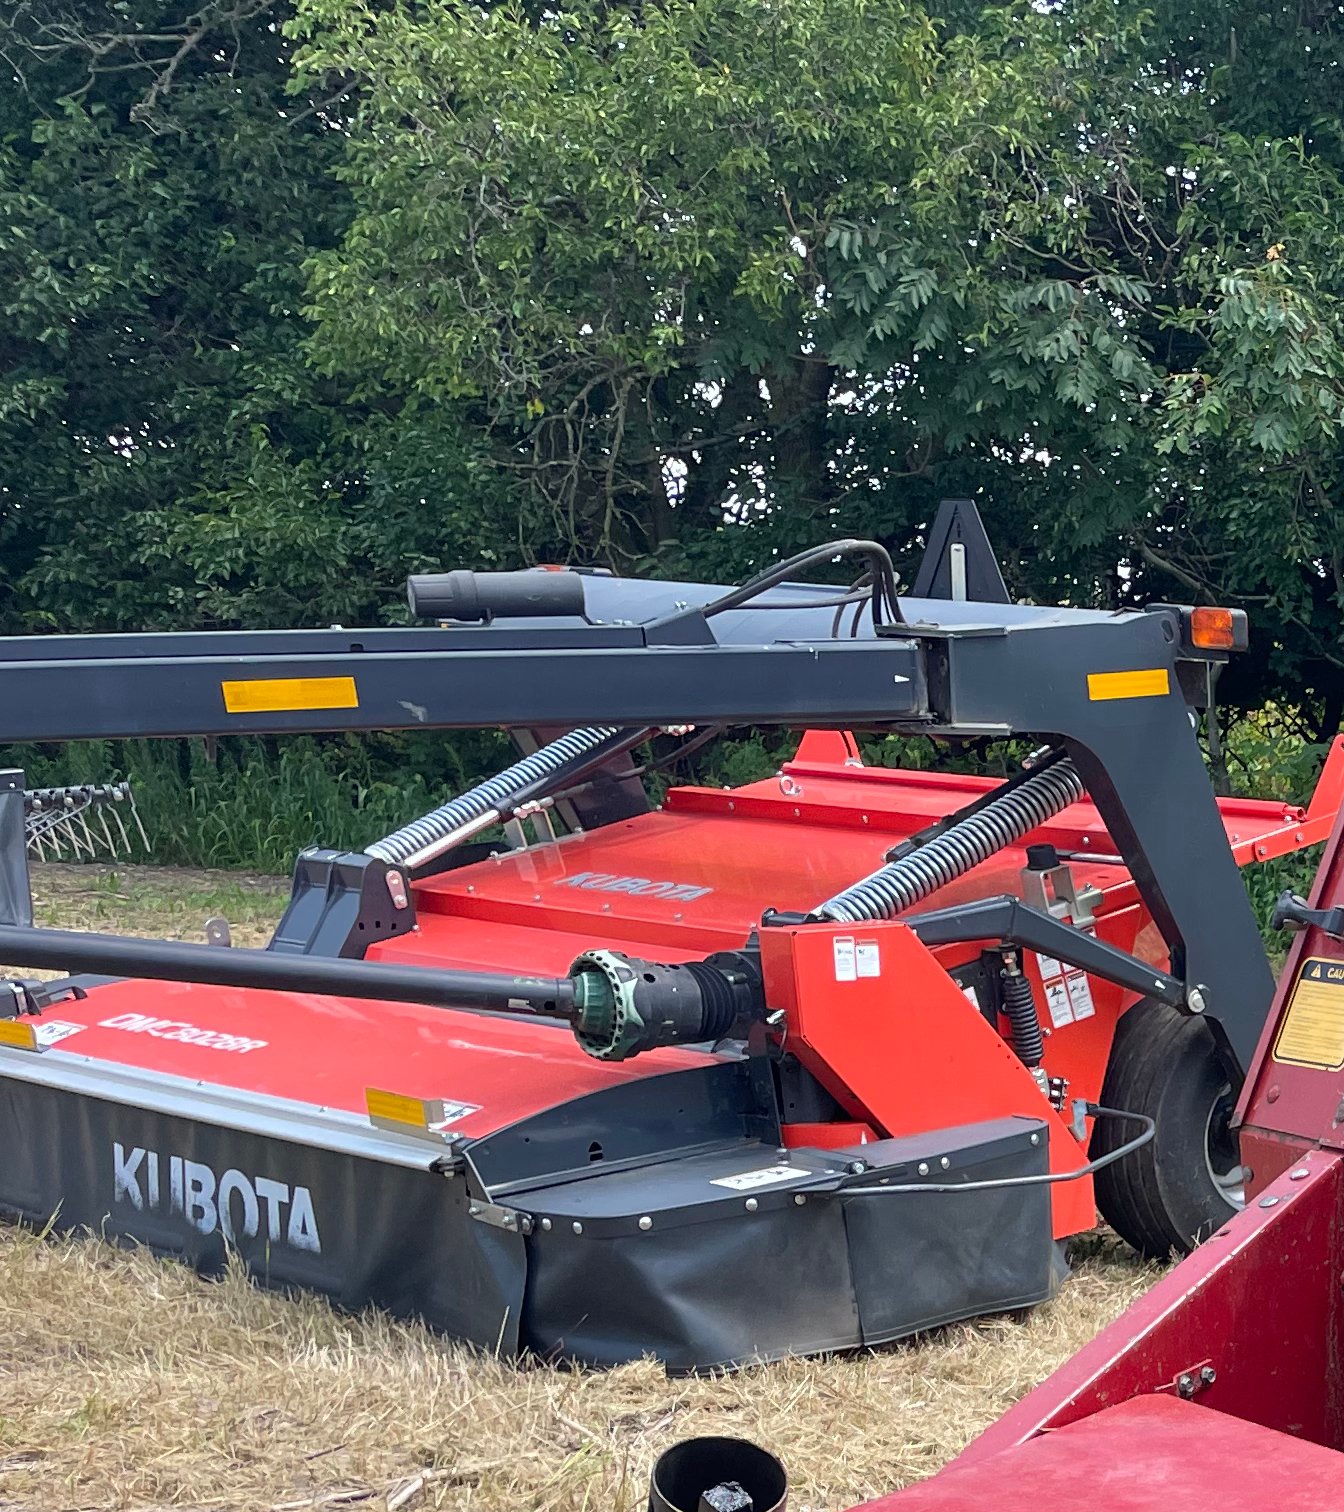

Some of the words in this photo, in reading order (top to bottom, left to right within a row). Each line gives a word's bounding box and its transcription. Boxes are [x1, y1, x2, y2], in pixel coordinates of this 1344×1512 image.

[553, 872, 714, 903] KUBOTA
[97, 1013, 269, 1054] DMC8028R
[113, 1141, 322, 1254] KUBOTA
